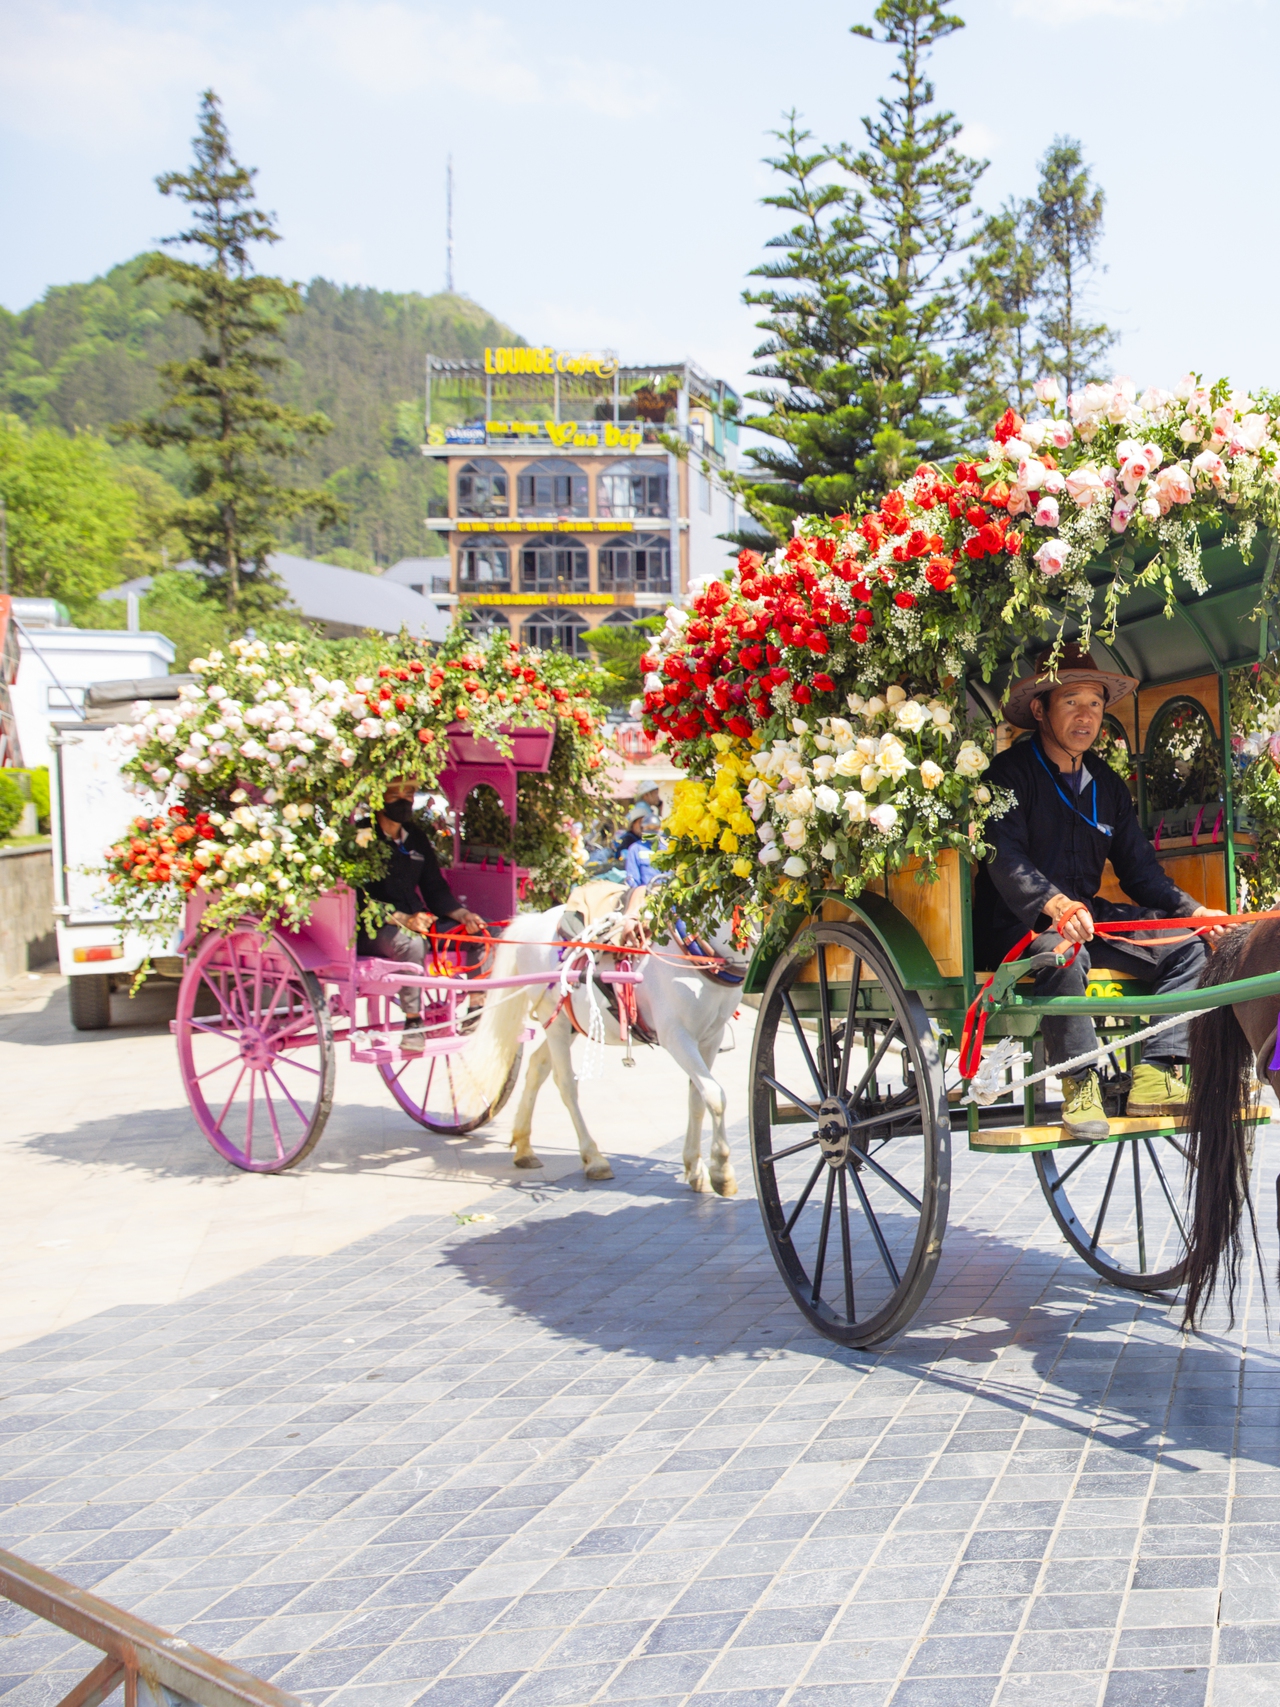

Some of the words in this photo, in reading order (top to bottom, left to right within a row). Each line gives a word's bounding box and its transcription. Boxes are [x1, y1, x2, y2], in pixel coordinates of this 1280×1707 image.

[485, 347, 555, 374] LOUNGE
[556, 350, 609, 378] Coffee
[1085, 982, 1124, 997] 06
